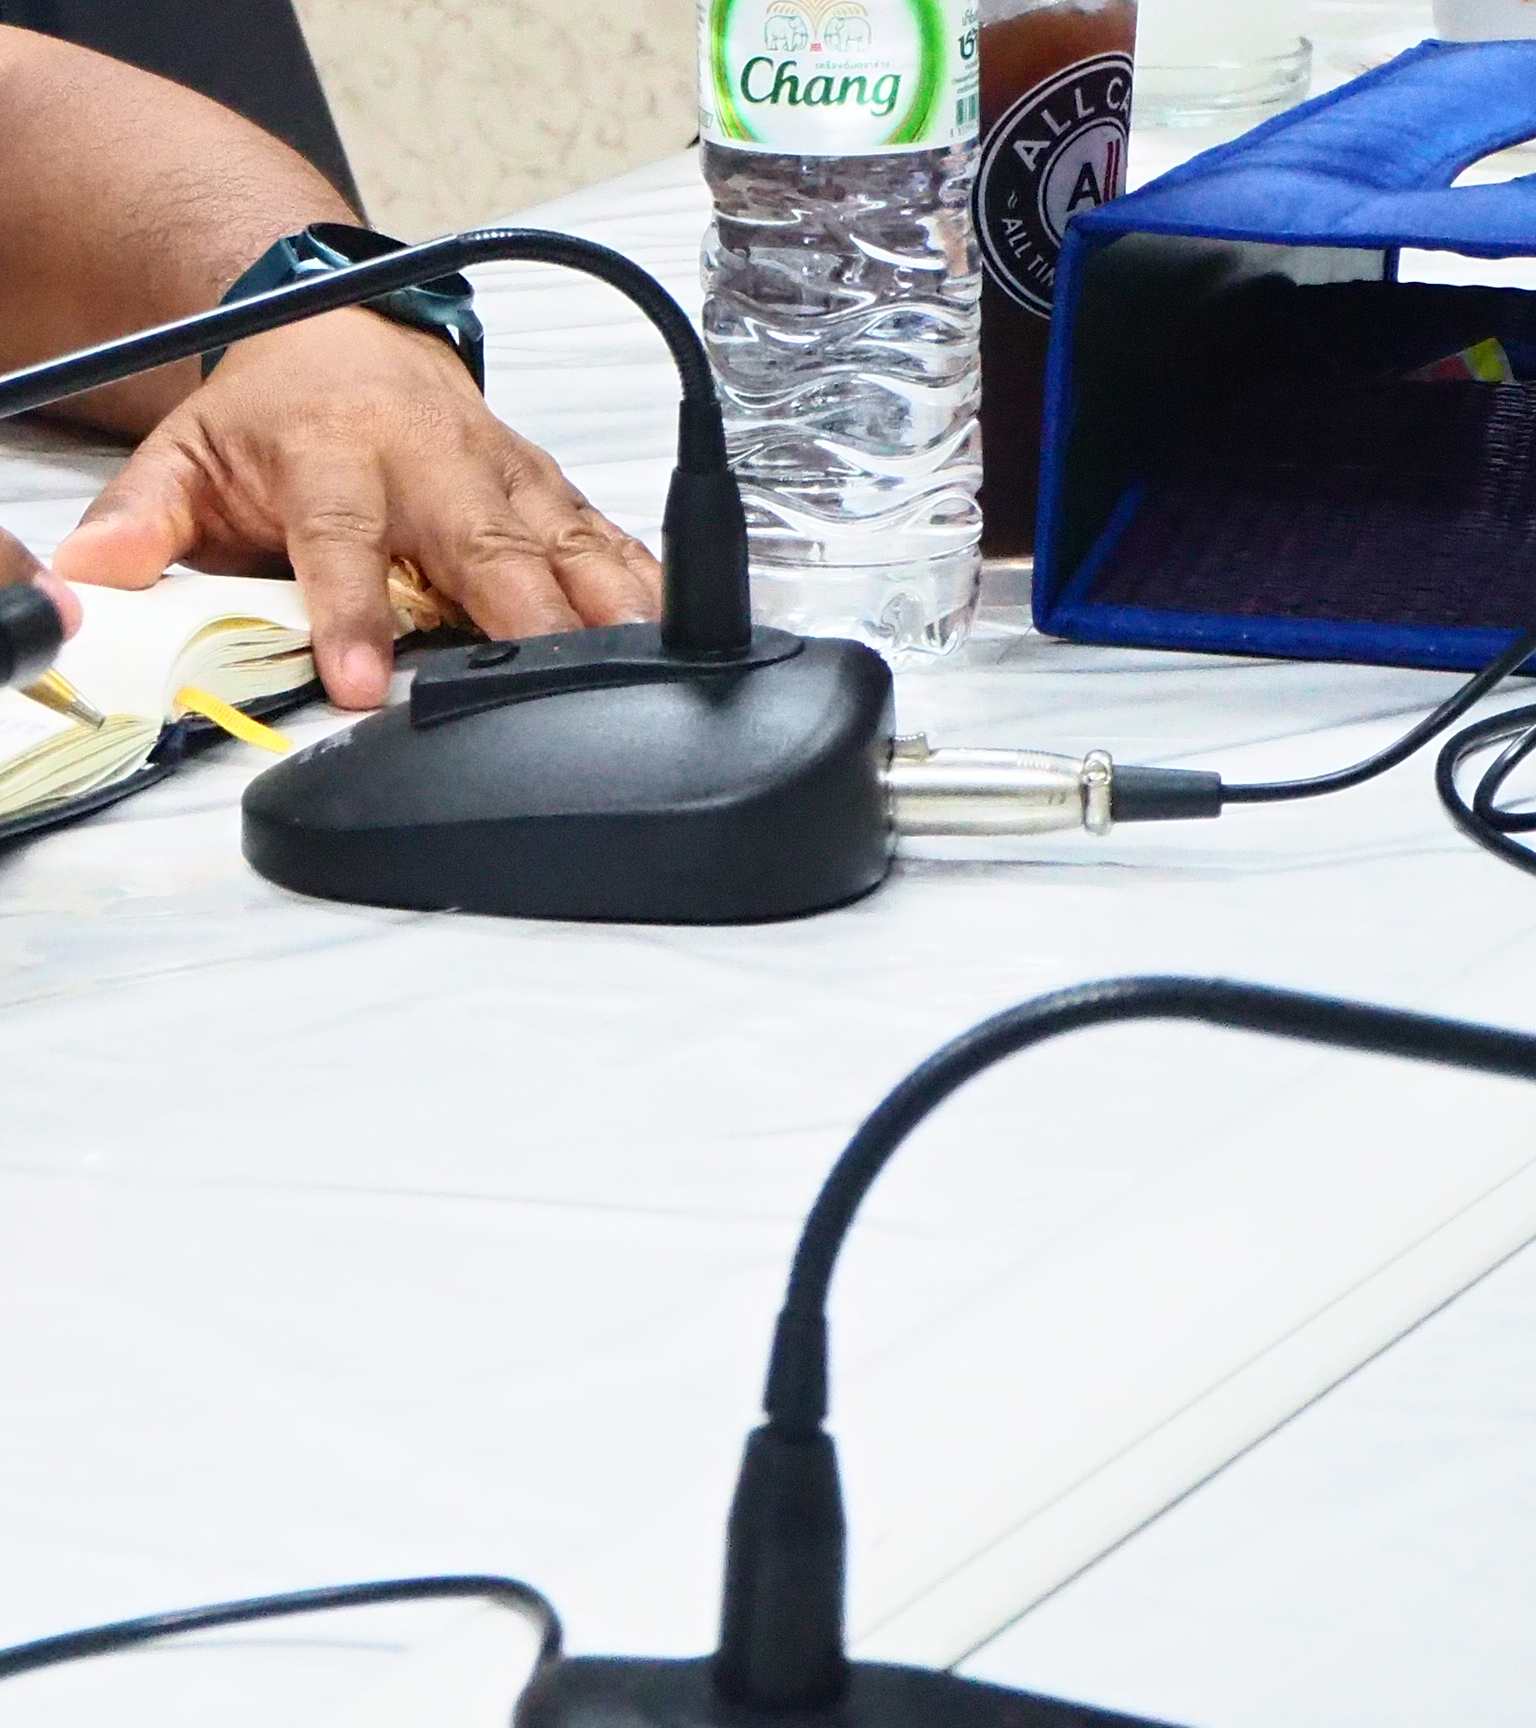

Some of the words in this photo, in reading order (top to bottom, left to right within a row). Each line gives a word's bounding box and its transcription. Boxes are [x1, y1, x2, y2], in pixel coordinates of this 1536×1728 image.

[740, 56, 902, 117] Chang
[1013, 87, 1095, 171] ALL
[1001, 218, 1032, 258] ALL
